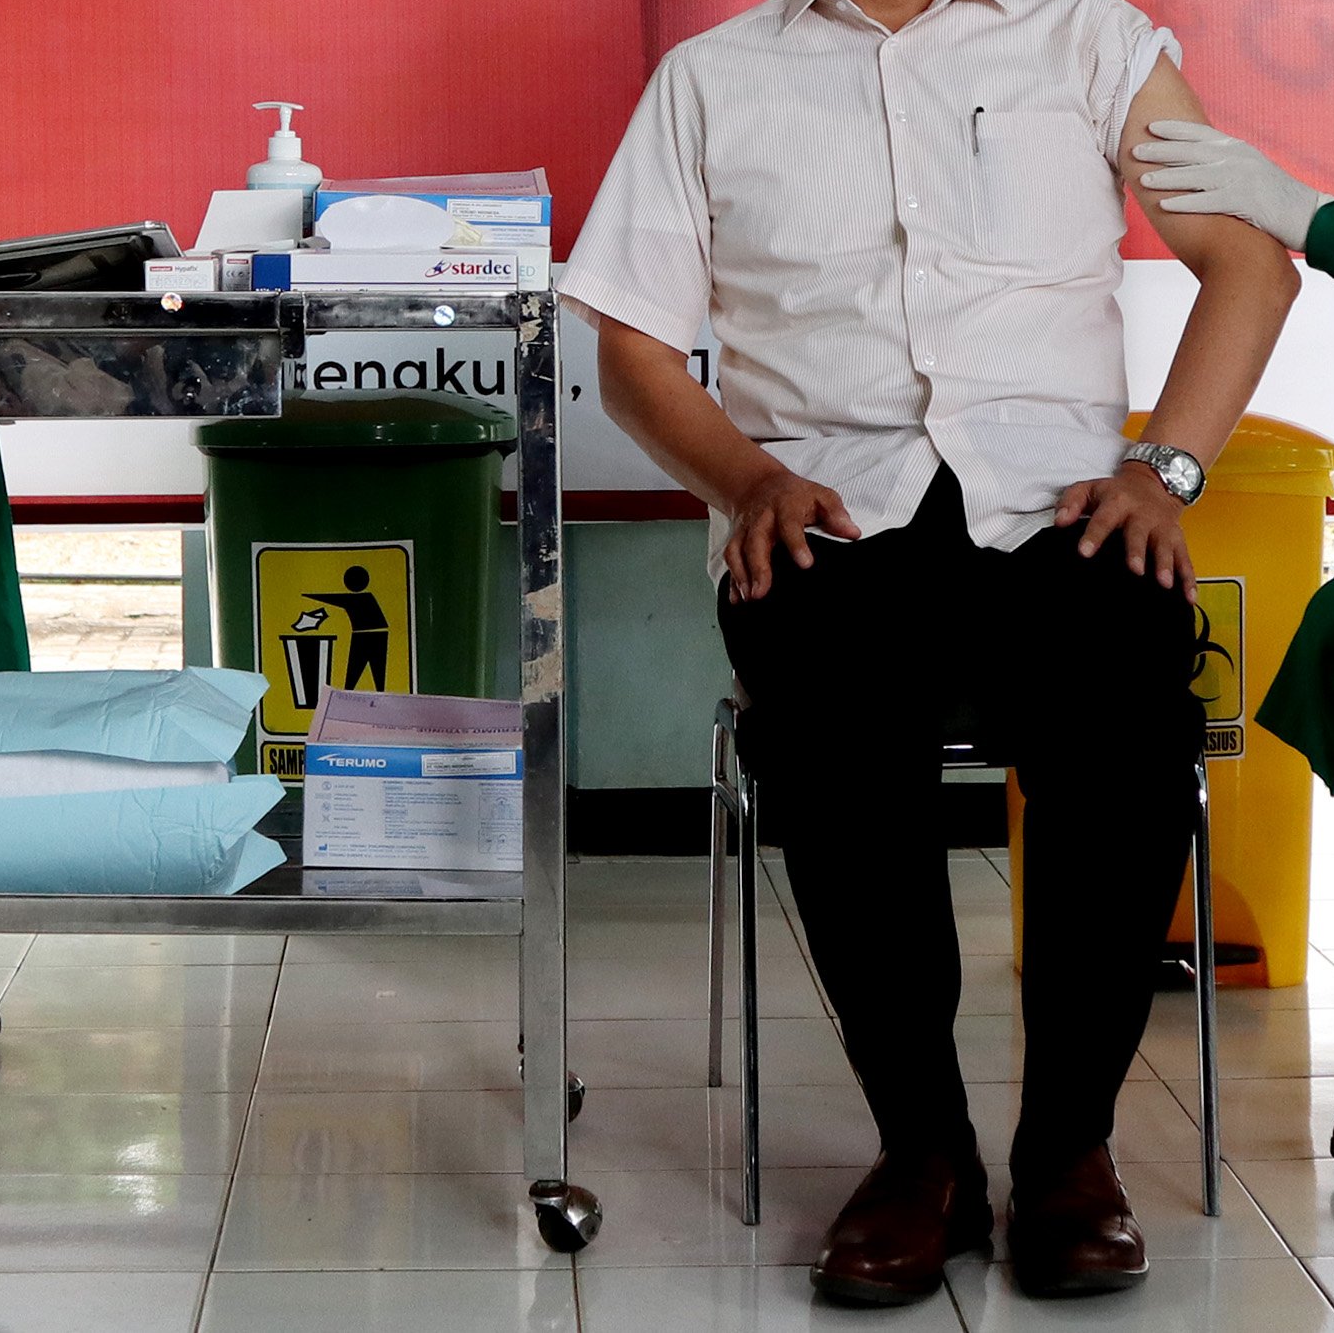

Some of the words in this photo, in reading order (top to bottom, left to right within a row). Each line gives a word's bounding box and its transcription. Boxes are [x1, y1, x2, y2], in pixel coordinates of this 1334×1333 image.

[519, 266, 531, 277] ED
[1205, 730, 1237, 752] SIUS
[269, 747, 305, 775] SAMP
[326, 757, 387, 769] TERUMO
